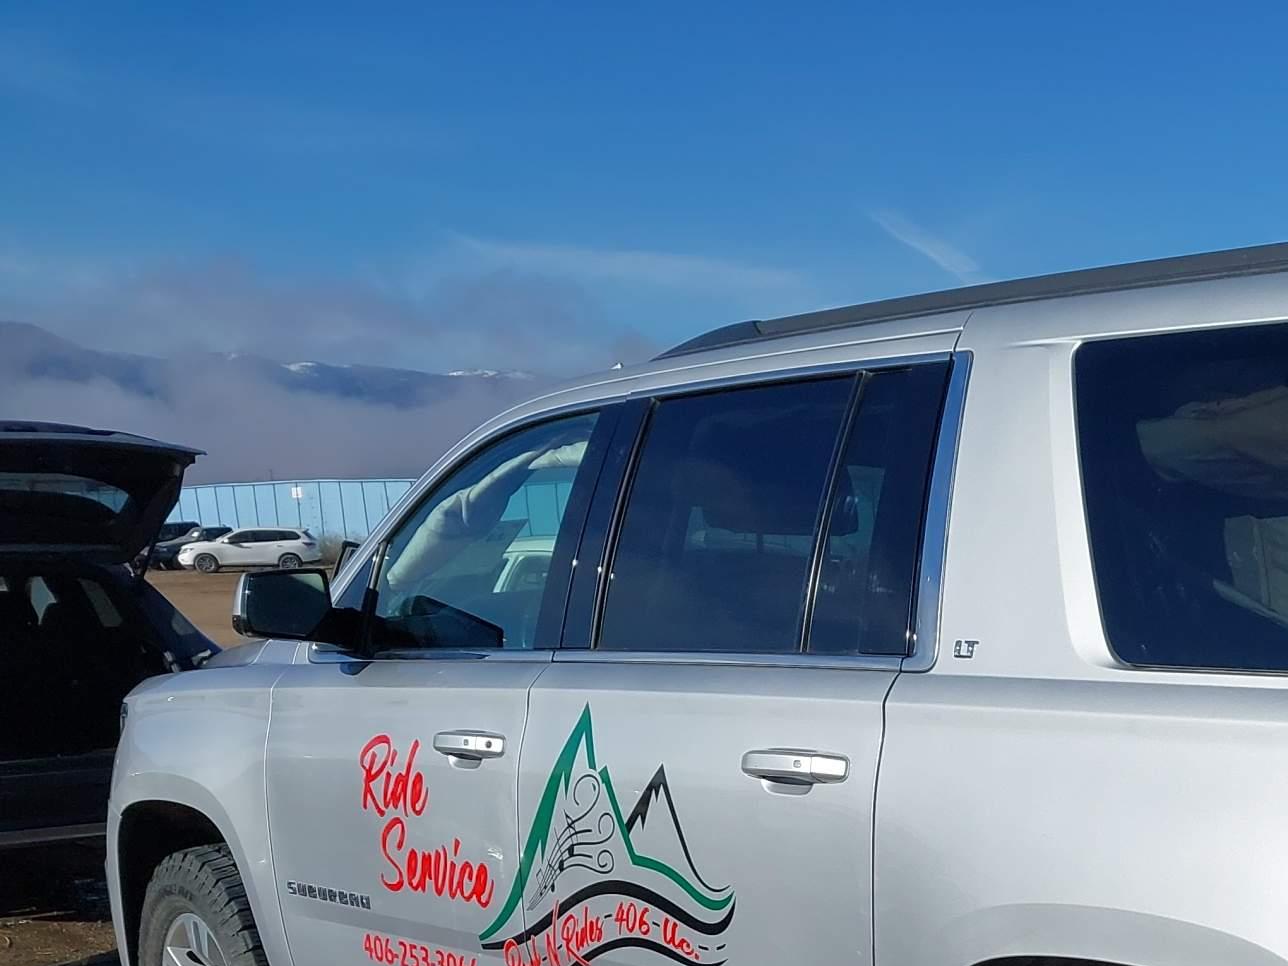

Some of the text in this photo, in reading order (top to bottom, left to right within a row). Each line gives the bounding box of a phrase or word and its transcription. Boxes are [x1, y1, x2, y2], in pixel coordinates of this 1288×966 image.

[953, 640, 980, 658] LT
[360, 734, 429, 818] Ride
[381, 816, 494, 909] Service
